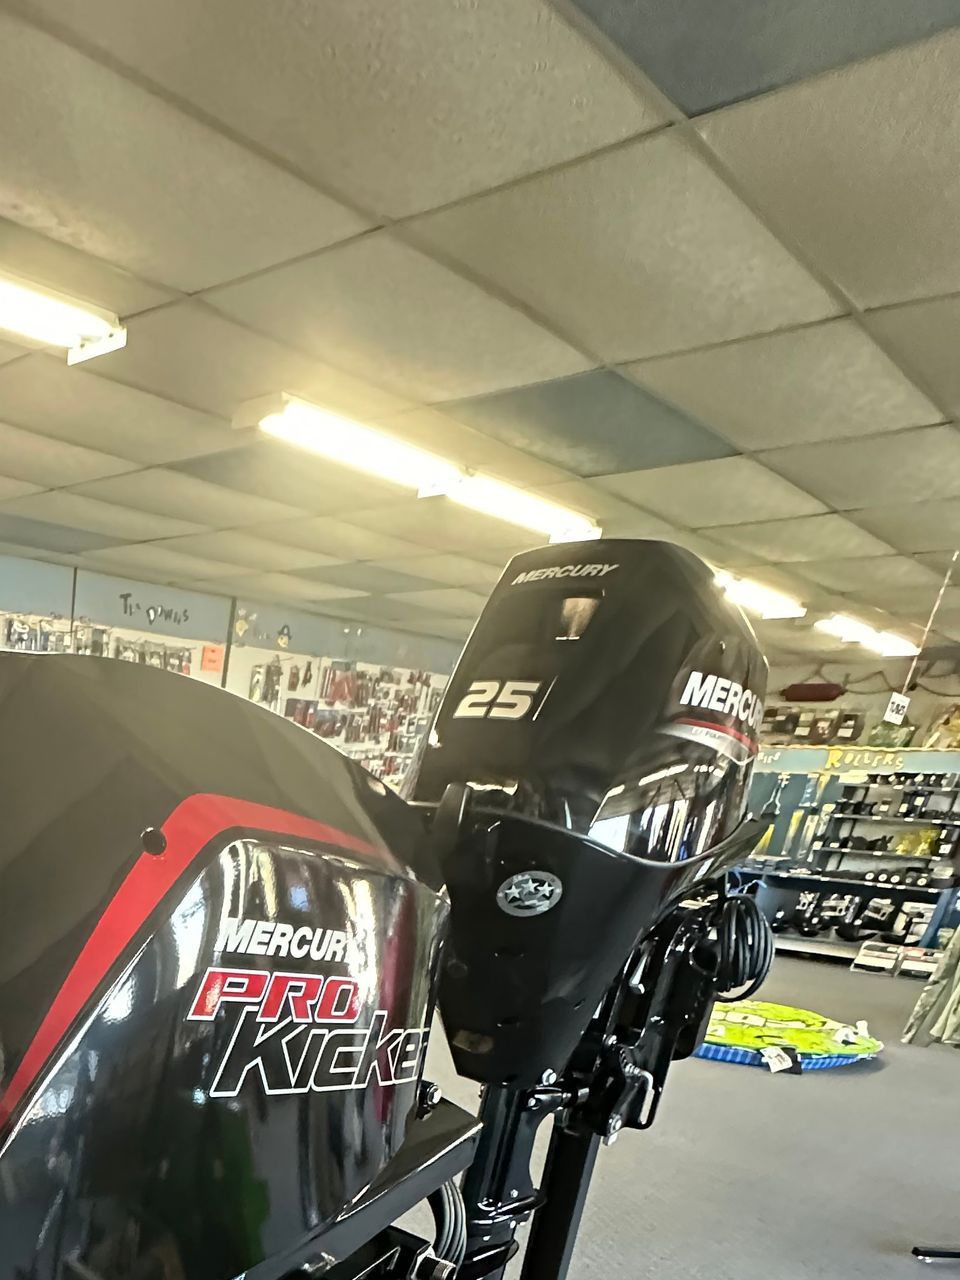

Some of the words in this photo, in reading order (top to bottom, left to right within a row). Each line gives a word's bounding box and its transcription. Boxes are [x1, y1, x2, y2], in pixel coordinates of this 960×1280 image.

[511, 563, 620, 586] MERCURY
[453, 680, 540, 721] 25
[680, 671, 764, 729] MERCUR
[187, 967, 363, 1023] PRO
